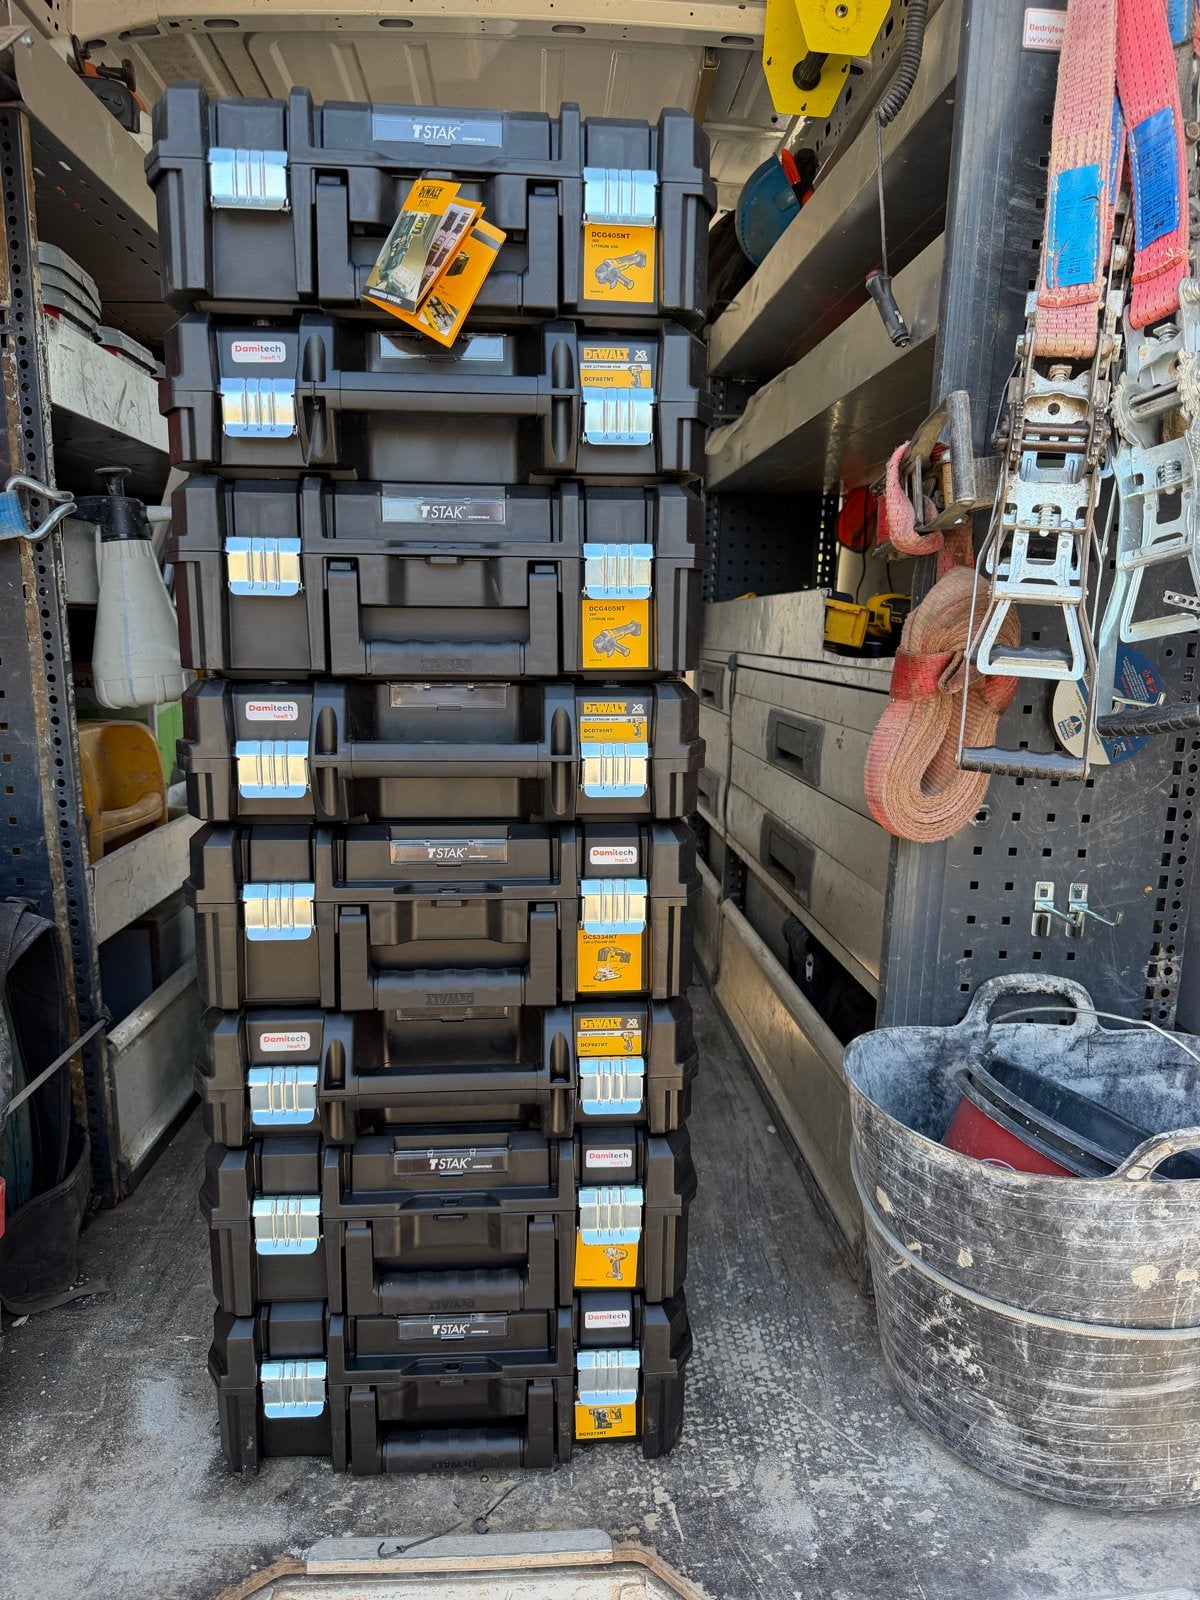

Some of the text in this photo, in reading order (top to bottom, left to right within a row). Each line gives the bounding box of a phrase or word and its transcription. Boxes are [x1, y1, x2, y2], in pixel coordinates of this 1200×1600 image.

[591, 231, 631, 239] DCG405NT
[234, 344, 281, 352] Damitech
[584, 348, 629, 361] DEWALT
[584, 702, 626, 714] DEWALT
[580, 1018, 622, 1029] DEWALT
